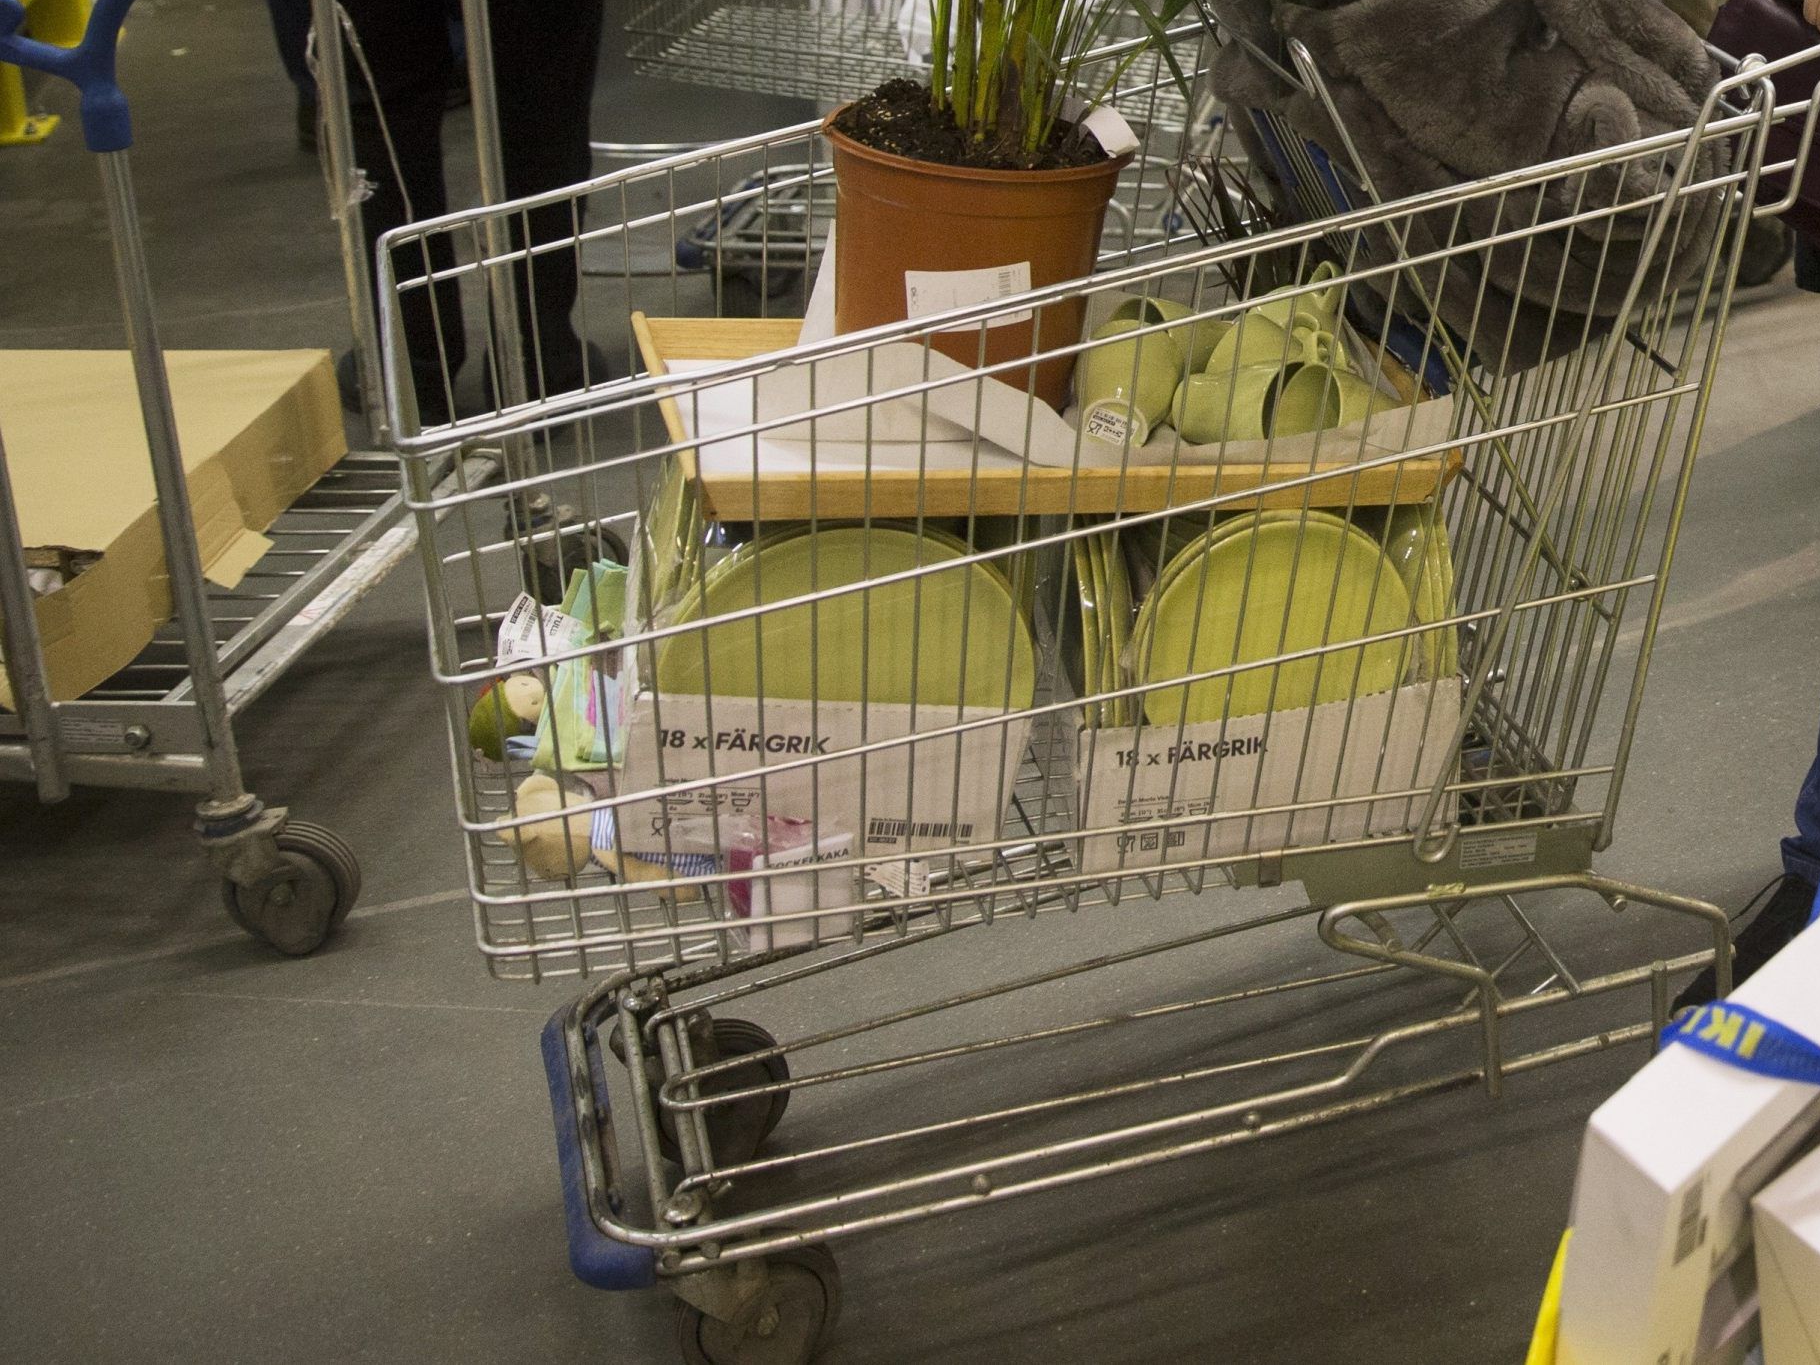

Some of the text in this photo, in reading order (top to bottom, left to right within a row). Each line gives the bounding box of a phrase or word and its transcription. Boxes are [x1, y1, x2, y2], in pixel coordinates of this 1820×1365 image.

[660, 729, 686, 749] 18
[1116, 749, 1139, 768] 18
[1147, 753, 1160, 766] x
